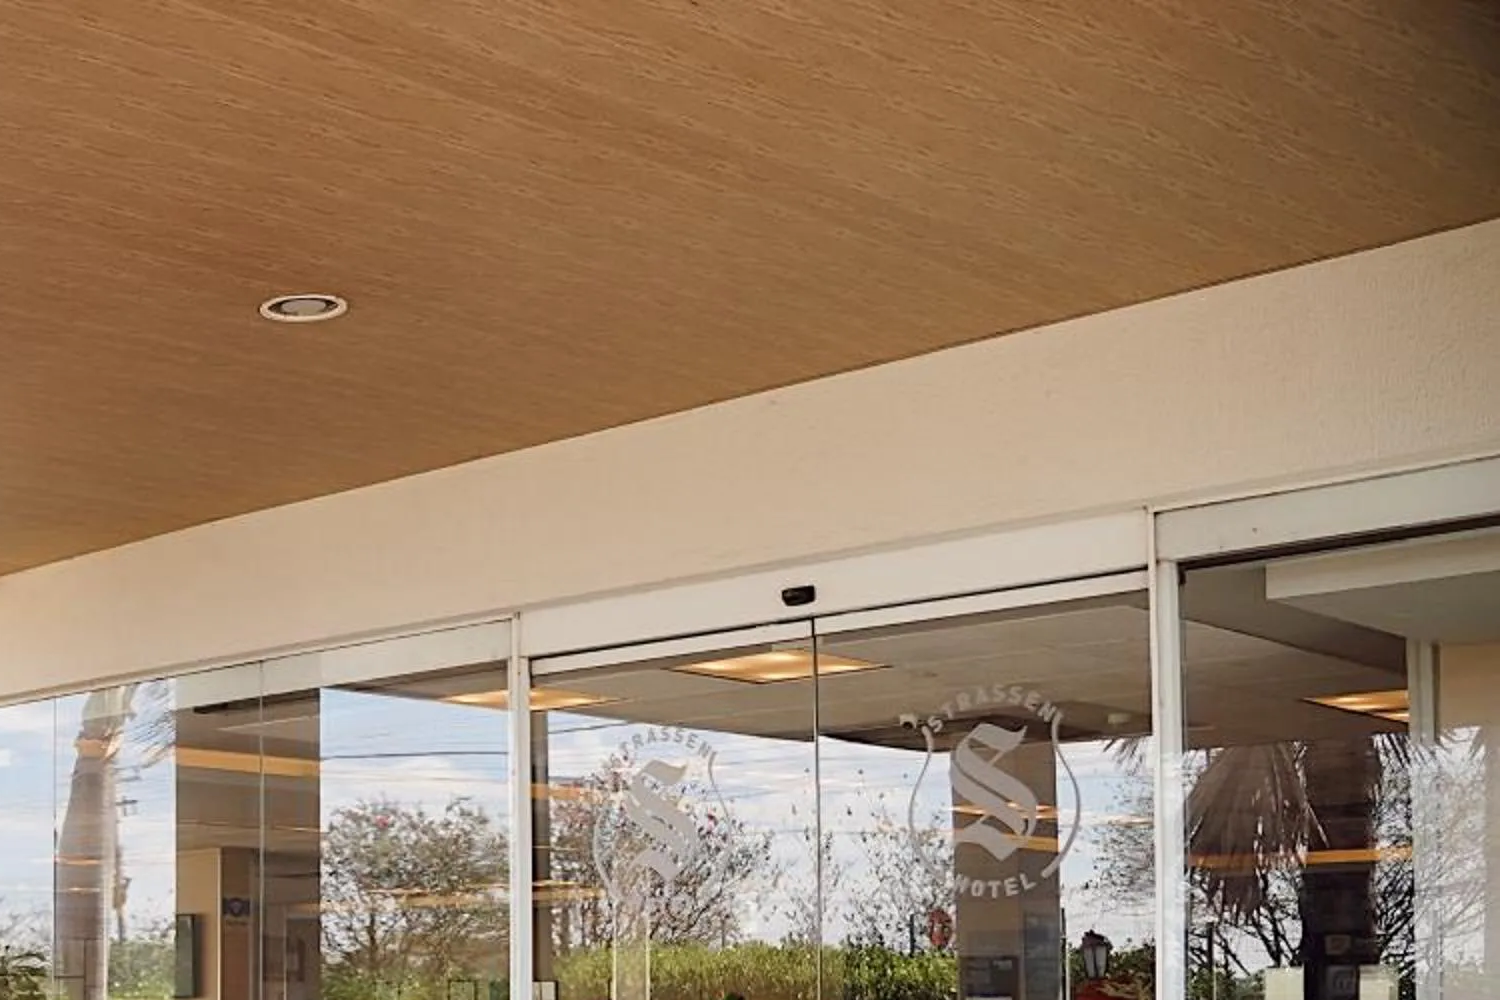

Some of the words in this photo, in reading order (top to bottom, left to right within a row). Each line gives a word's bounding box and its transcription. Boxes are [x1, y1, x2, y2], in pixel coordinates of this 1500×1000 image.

[927, 683, 1059, 734] STRASSEN
[606, 727, 713, 765] TRASSEN
[954, 871, 1037, 899] HOTEL
